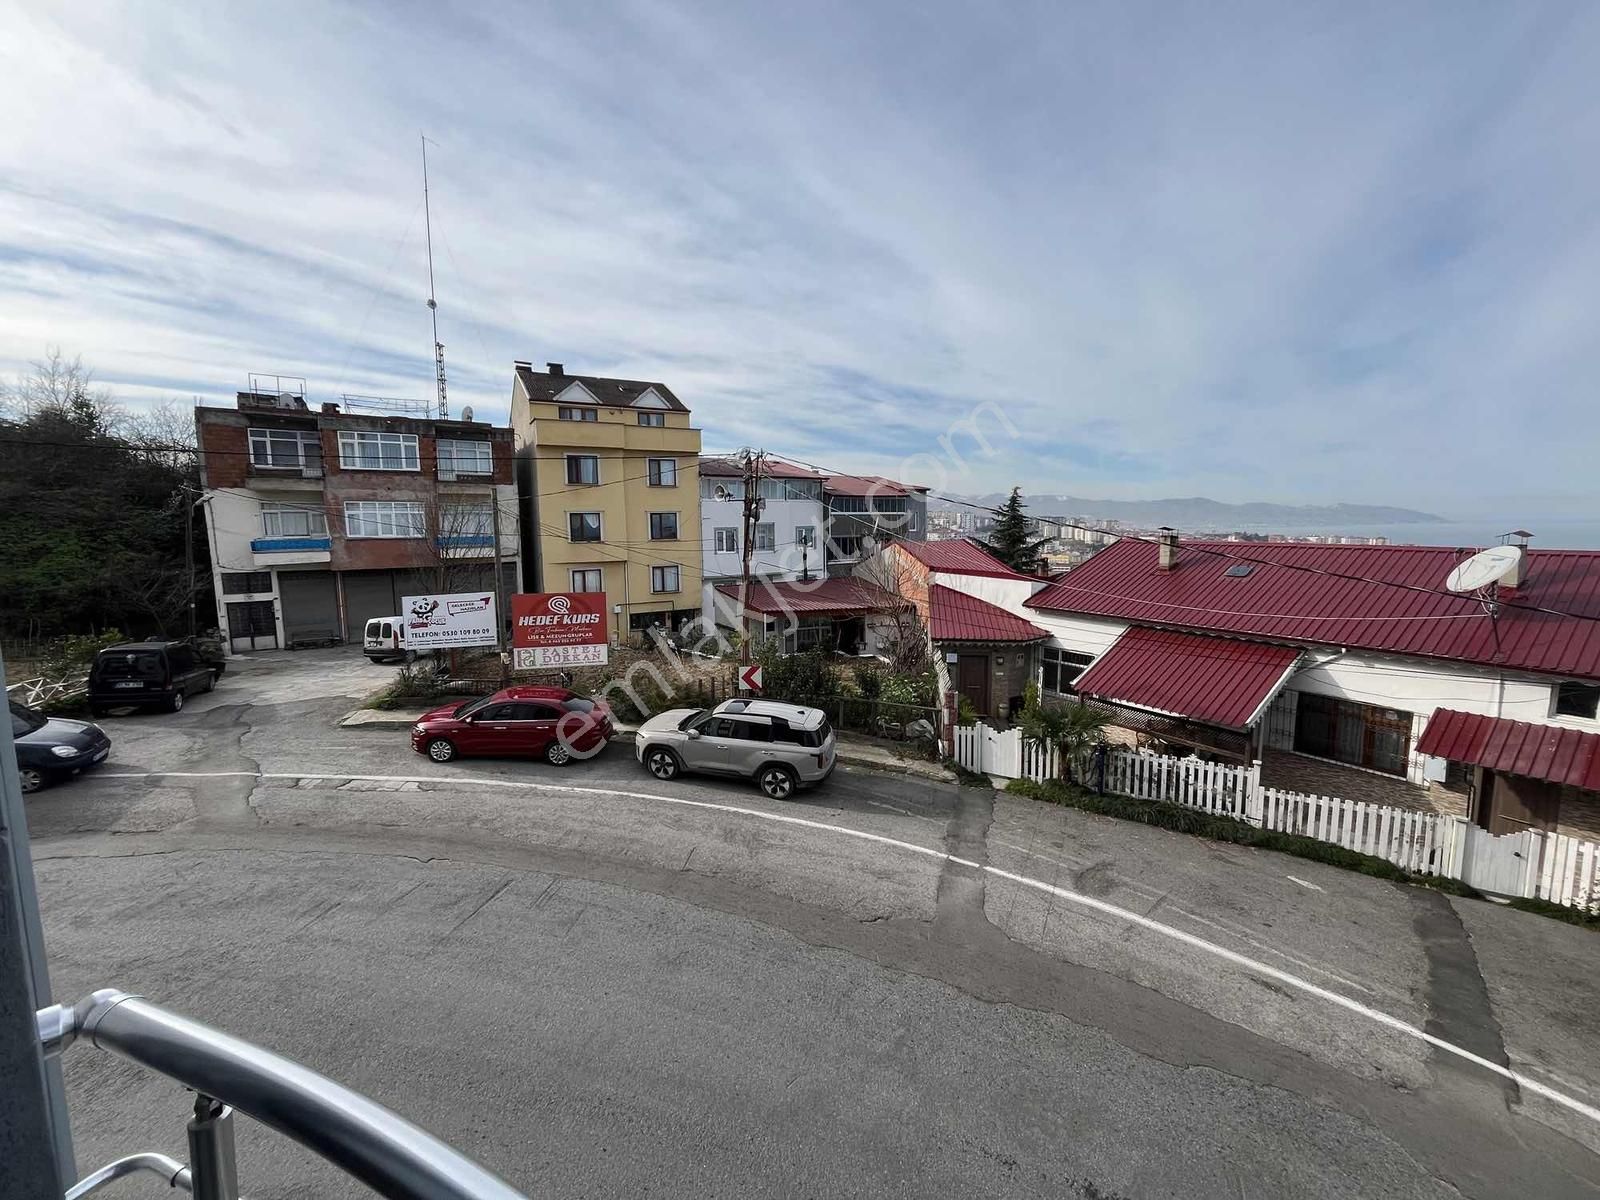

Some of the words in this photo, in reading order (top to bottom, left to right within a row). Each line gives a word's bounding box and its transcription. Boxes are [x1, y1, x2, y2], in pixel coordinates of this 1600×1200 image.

[519, 615, 561, 626] HEDEF
[563, 613, 600, 624] KURS
[542, 646, 601, 656] PASTEL
